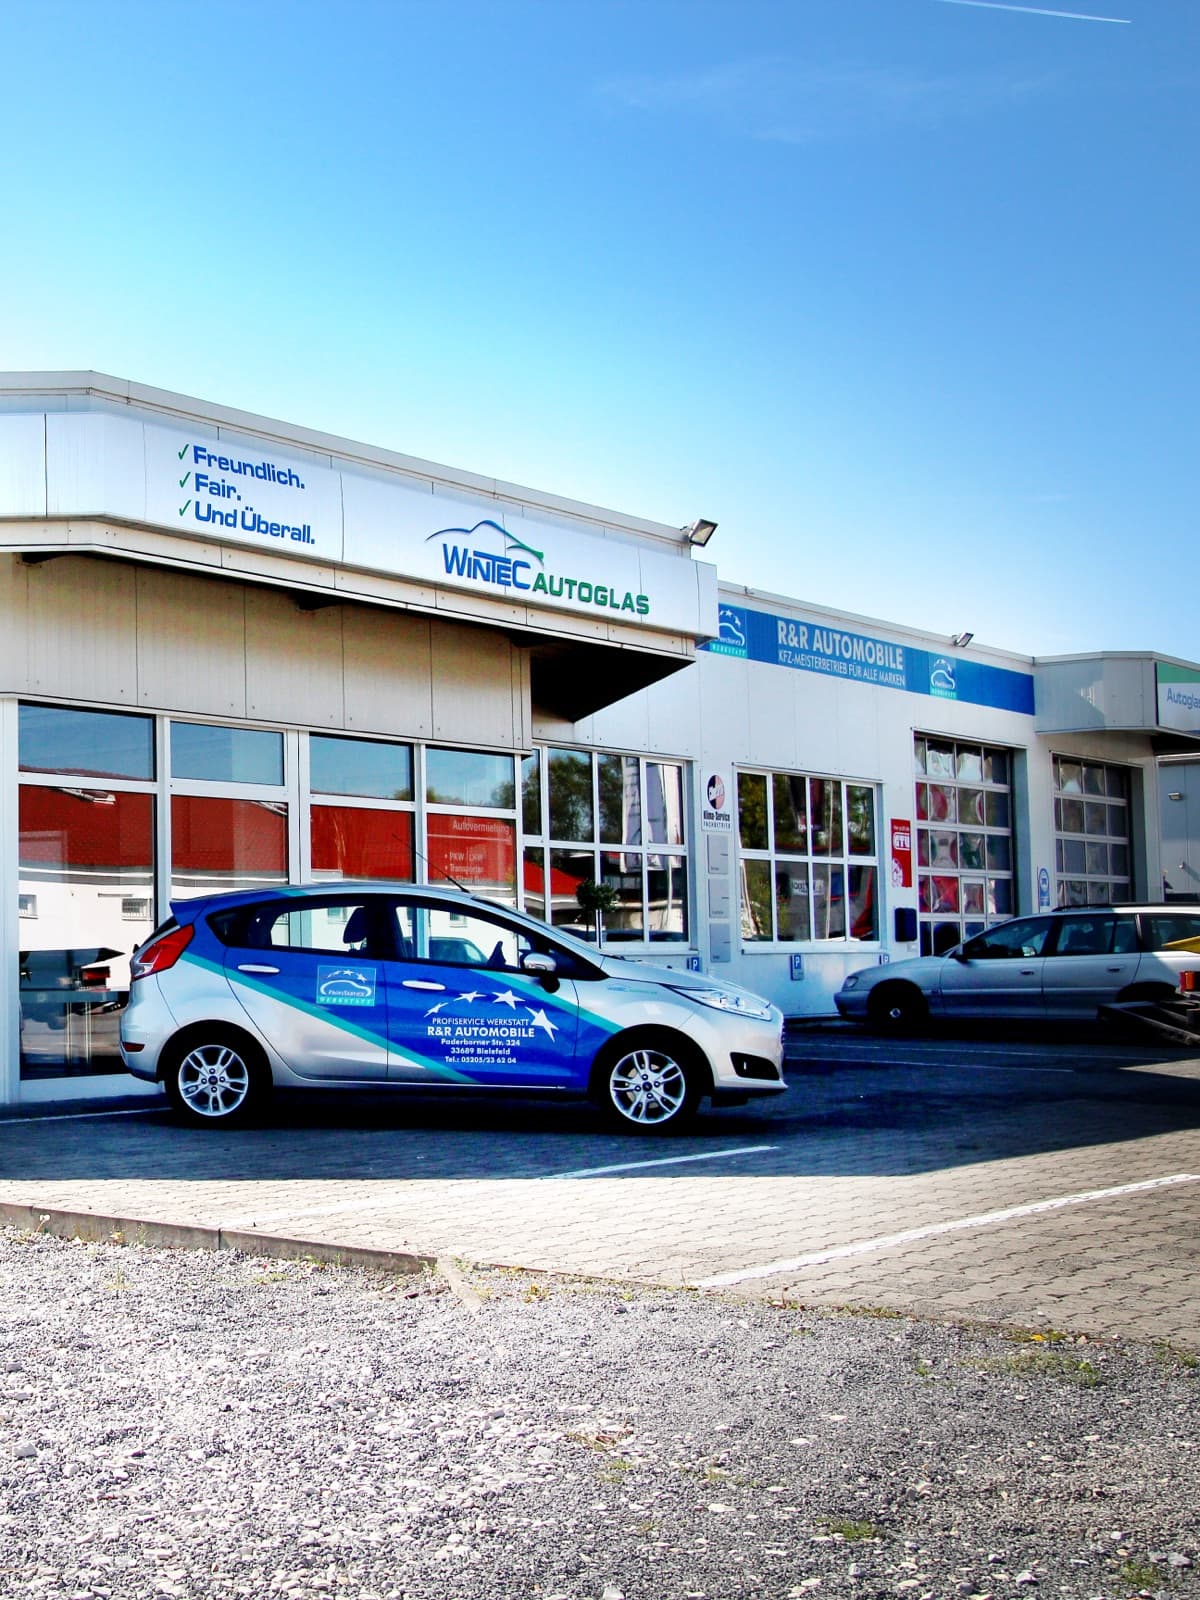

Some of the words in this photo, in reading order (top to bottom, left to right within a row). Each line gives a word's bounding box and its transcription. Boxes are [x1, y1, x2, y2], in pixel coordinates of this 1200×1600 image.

[193, 445, 305, 489] Freundlich.
[195, 472, 241, 501] Fair.
[195, 501, 237, 528] Und
[241, 505, 315, 545] Überall.
[532, 572, 650, 615] AUTOGLAS
[777, 620, 808, 649] R&R
[813, 629, 904, 670] AUTOMOBILE
[778, 649, 848, 674] KFZ-MEISTERBETRIEB
[848, 663, 862, 678] FÜR
[863, 666, 878, 682] ALLE
[879, 671, 905, 687] MARKEN
[1167, 687, 1200, 710] Autogla
[427, 1026, 451, 1037] R&R
[455, 1027, 535, 1038] AUTOMOBILE
[432, 1017, 485, 1026] PROFISERVICE
[487, 1018, 529, 1026] WERKSTATT
[441, 1038, 489, 1046] Paderborner
[451, 1047, 474, 1055] 33689
[477, 1047, 511, 1055] Bielefeld
